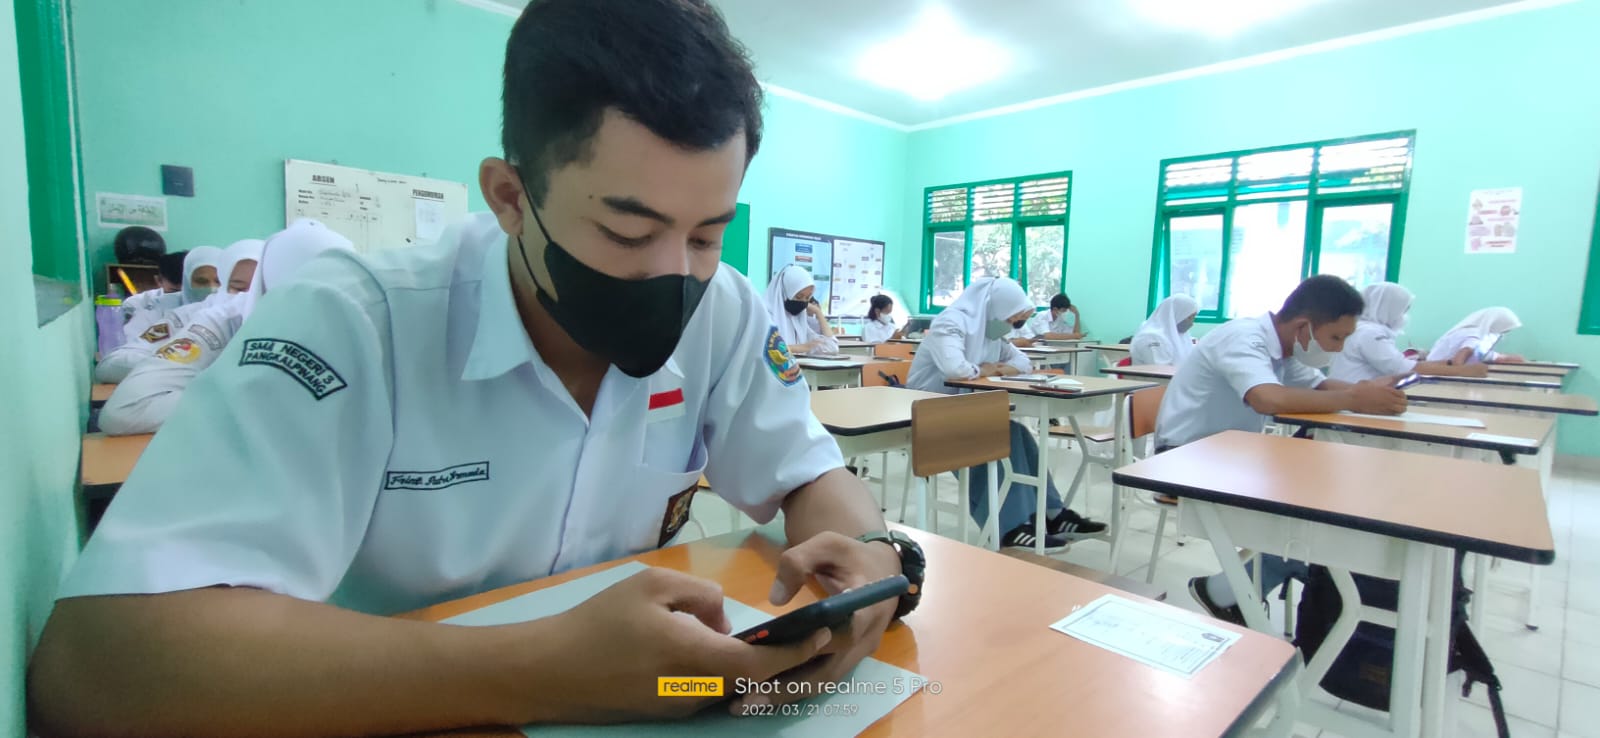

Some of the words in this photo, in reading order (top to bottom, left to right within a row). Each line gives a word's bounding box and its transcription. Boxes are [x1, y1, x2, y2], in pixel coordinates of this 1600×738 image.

[245, 352, 326, 393] PANGKALPINANG
[248, 342, 274, 351] SMA
[280, 344, 326, 376] NEGERI
[322, 375, 335, 386] 3
